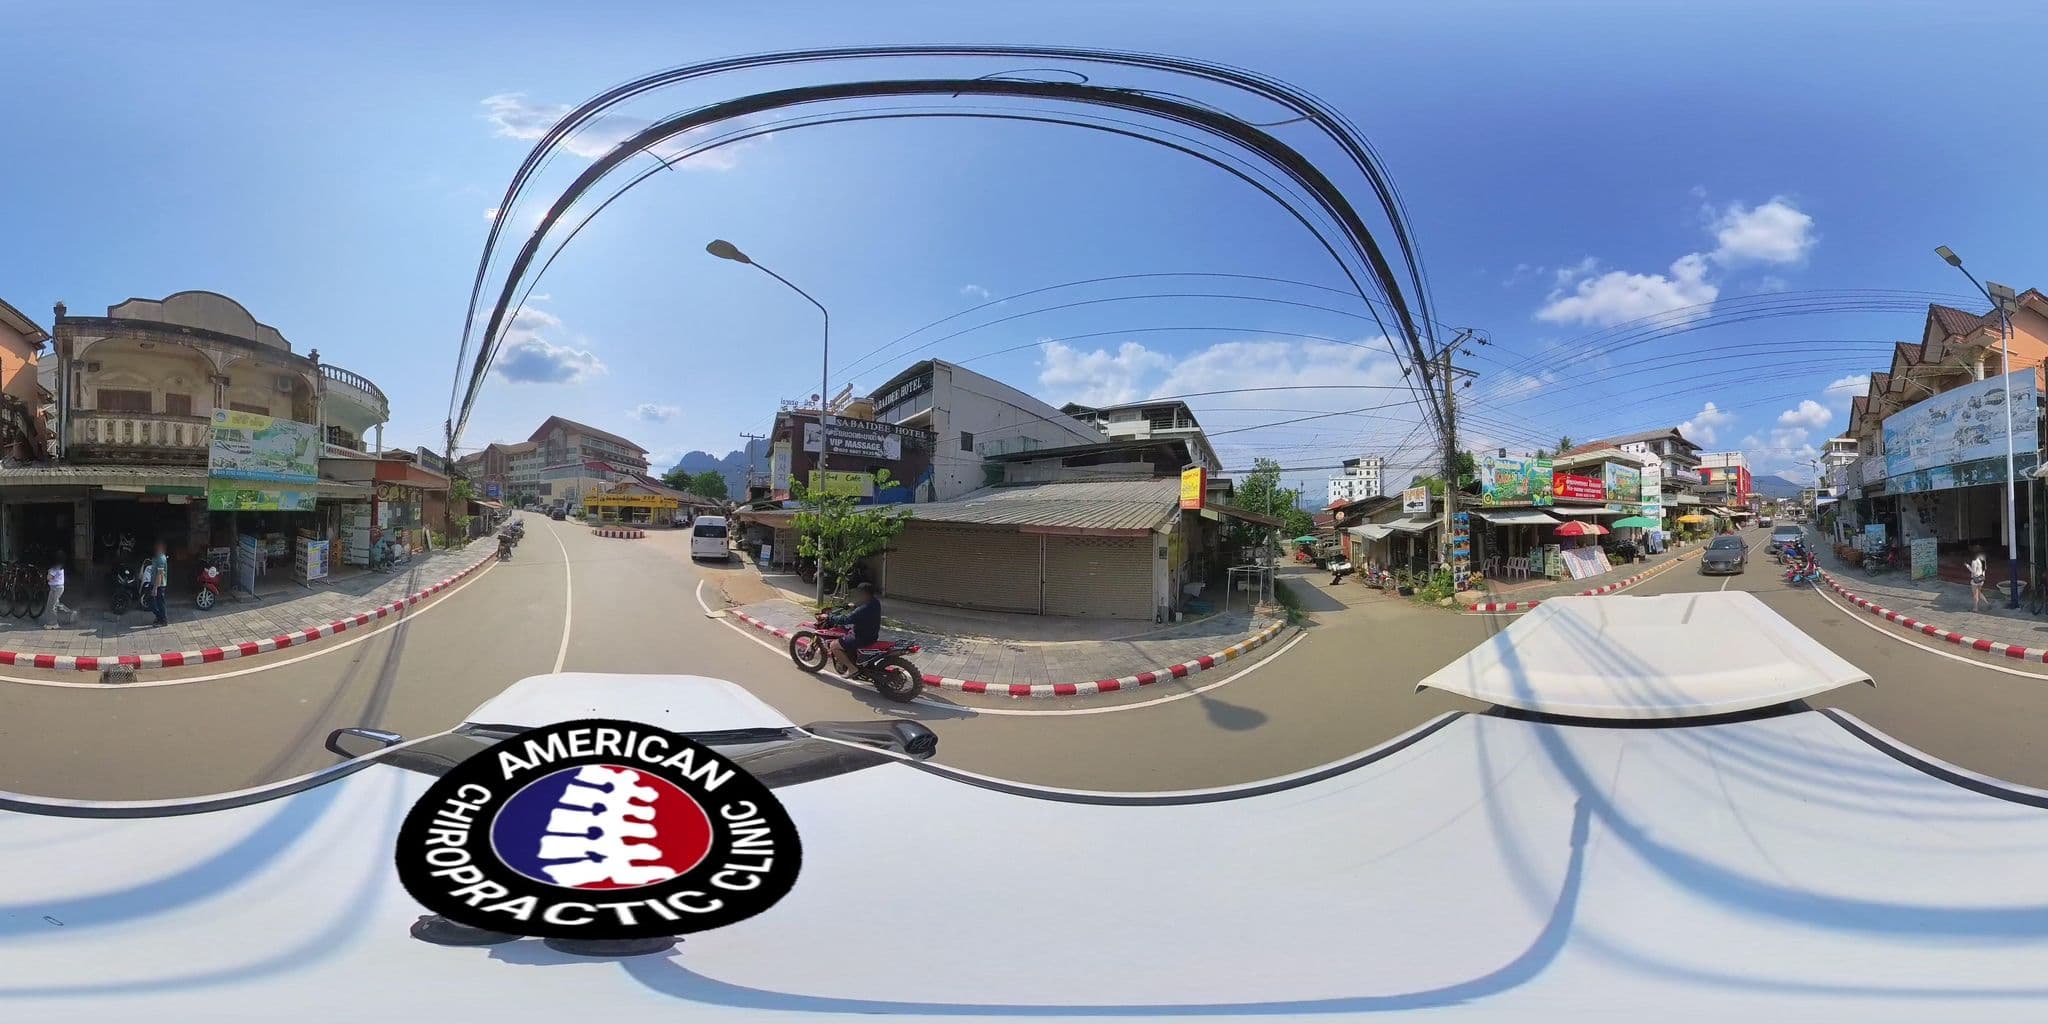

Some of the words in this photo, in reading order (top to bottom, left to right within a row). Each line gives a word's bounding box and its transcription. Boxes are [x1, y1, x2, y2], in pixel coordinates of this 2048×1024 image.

[900, 377, 922, 398] HOTEL
[836, 418, 891, 432] SABAIDEE
[895, 427, 926, 439] HOTEL
[829, 438, 843, 446] VIP
[844, 440, 881, 451] MASSAGE
